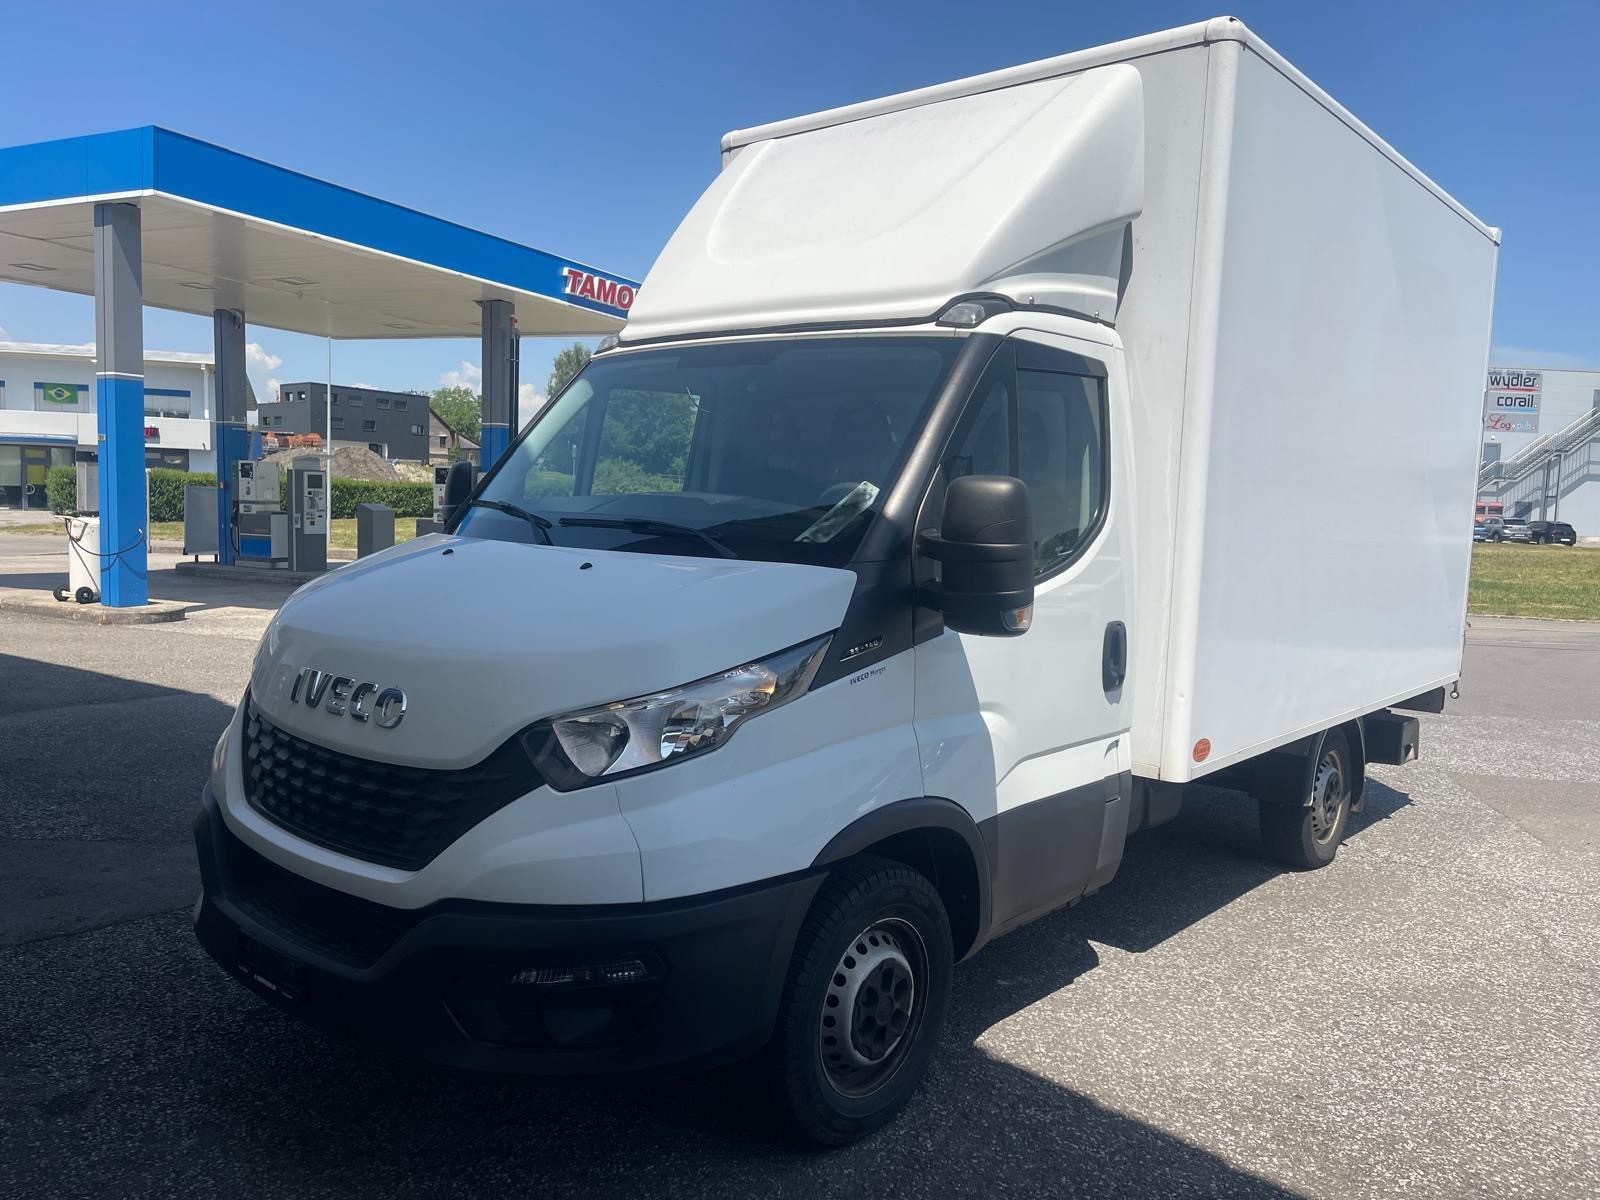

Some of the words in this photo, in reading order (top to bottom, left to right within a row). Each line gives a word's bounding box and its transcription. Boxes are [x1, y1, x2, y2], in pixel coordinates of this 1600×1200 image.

[562, 267, 639, 310] TAMO
[1496, 394, 1535, 408] corail
[849, 672, 869, 685] IVECO
[290, 666, 408, 729] IVECO
